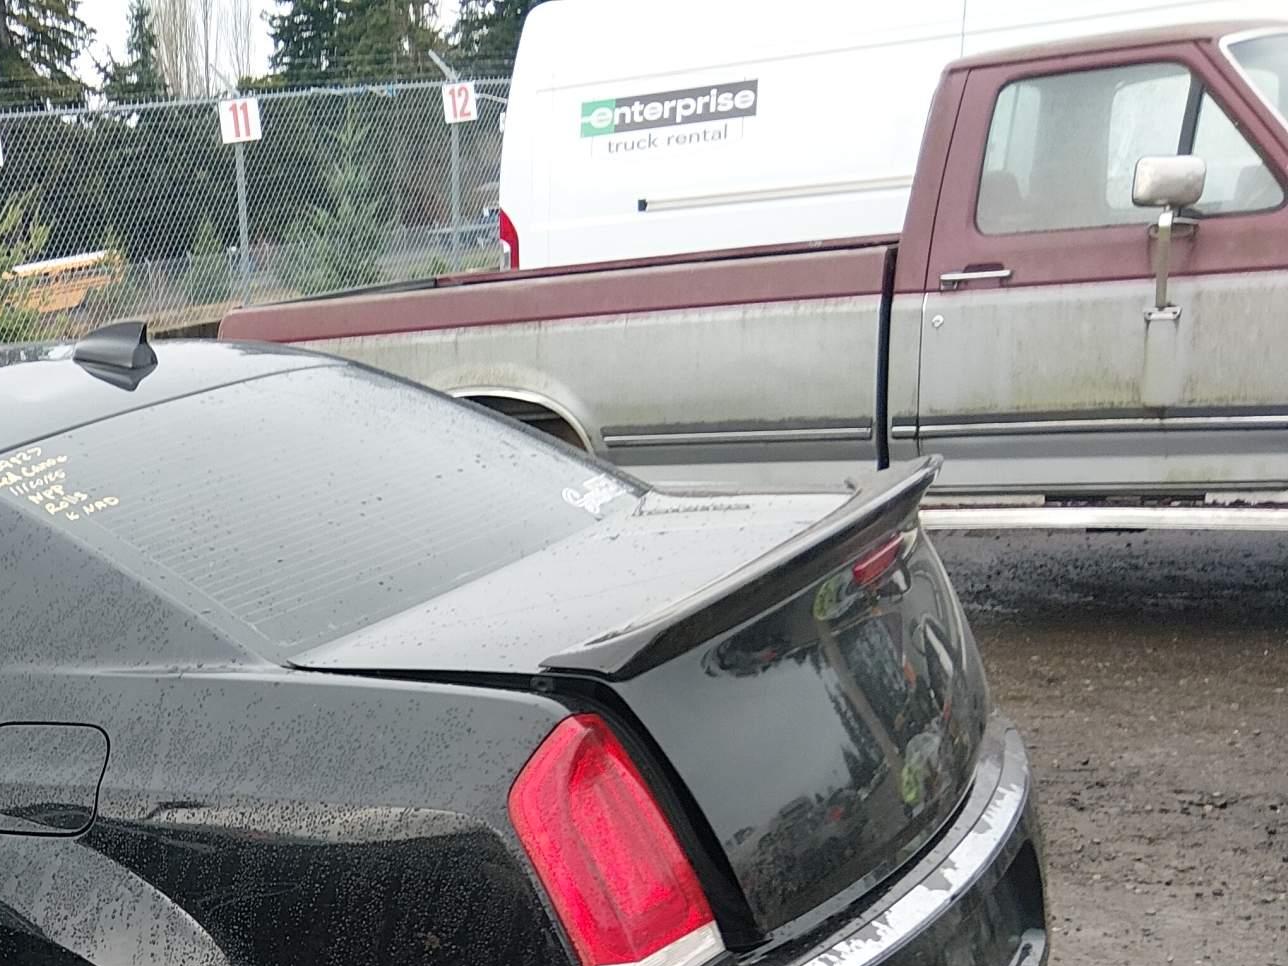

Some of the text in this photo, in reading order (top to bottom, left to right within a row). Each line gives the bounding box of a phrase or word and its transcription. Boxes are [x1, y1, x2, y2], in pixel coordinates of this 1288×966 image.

[448, 86, 472, 119] 12
[581, 88, 756, 128] enterprise
[229, 102, 251, 138] 11
[608, 124, 729, 154] truck rental
